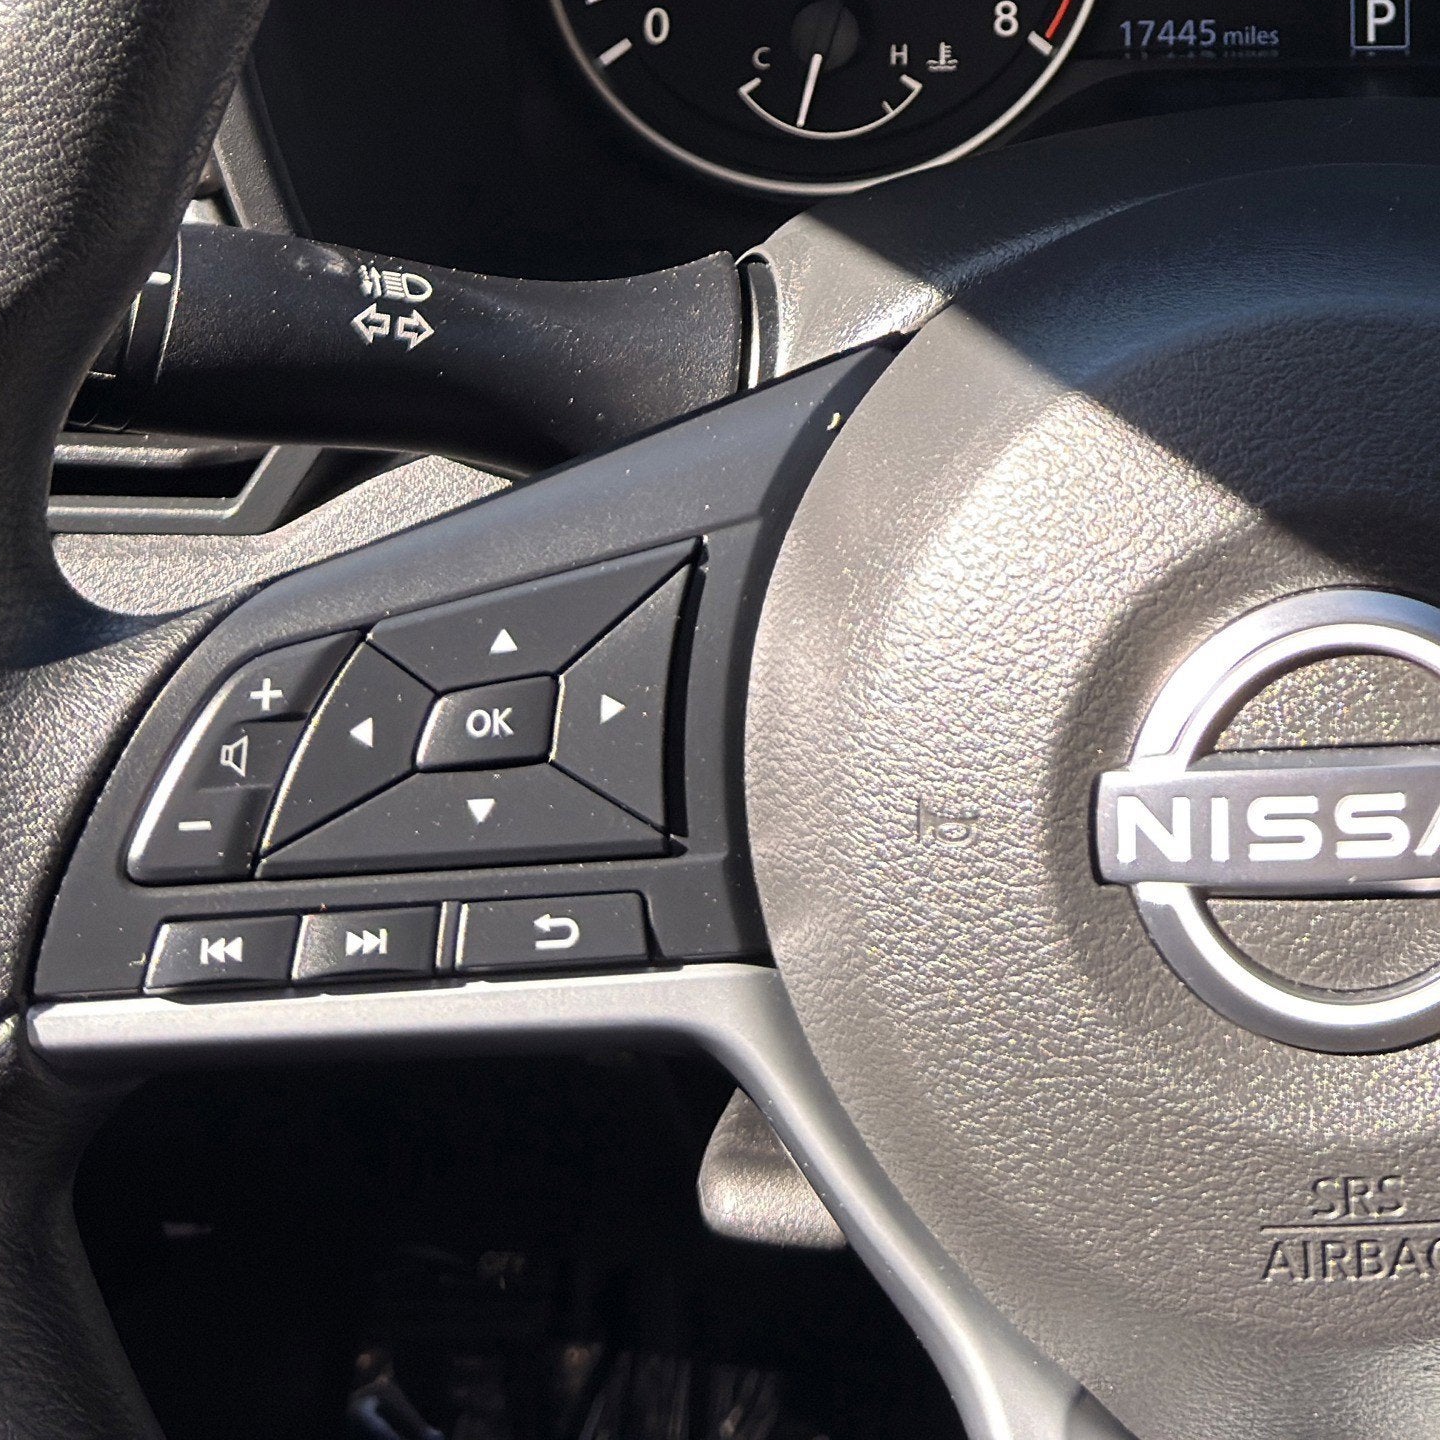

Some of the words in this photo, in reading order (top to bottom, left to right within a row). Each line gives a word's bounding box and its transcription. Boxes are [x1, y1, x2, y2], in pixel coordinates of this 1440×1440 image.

[643, 7, 670, 45] 0
[993, 0, 1019, 37] 8
[1119, 20, 1217, 47] 17445
[1223, 25, 1280, 46] miles
[752, 46, 771, 69] C
[891, 44, 908, 66] H
[465, 707, 514, 738] OK
[1309, 1174, 1407, 1220] SRS
